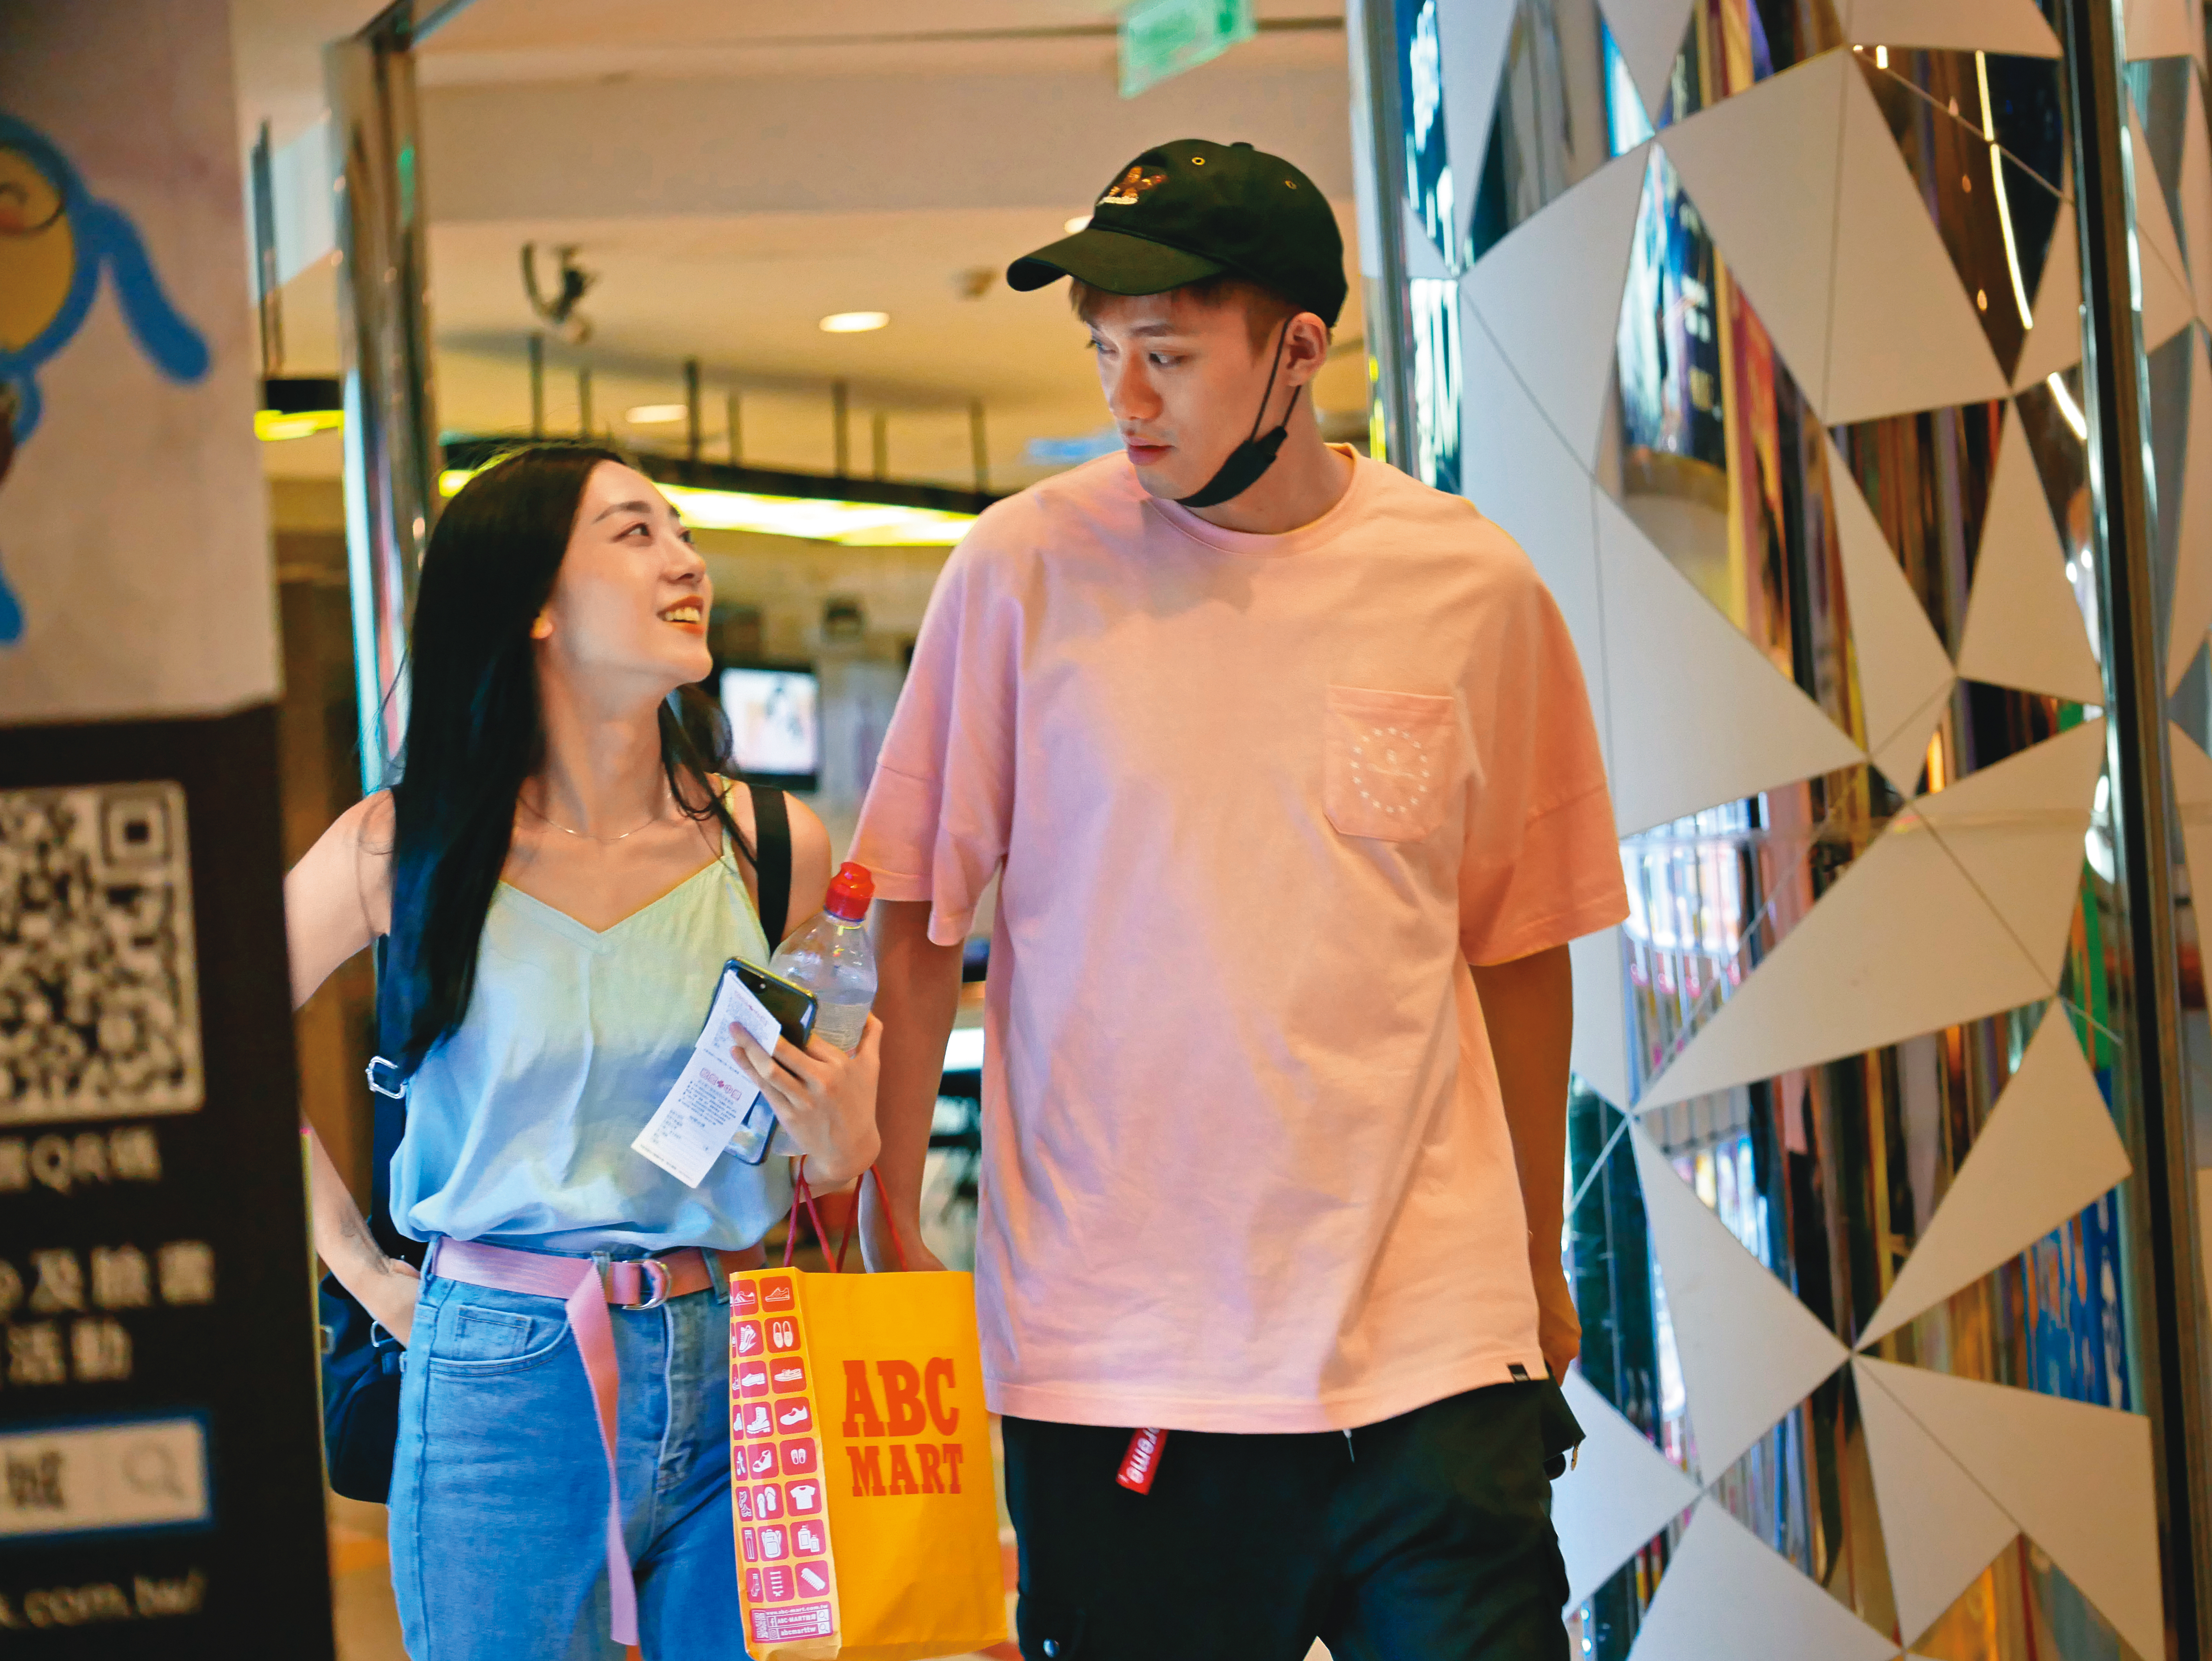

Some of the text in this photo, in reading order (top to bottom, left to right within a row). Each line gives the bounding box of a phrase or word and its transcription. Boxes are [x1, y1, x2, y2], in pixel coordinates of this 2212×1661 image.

[842, 1357, 960, 1437] ABC
[846, 1443, 964, 1497] MART
[766, 1604, 828, 1616] www.abc-mart.com.tw
[780, 1625, 816, 1636] abcmarttw
